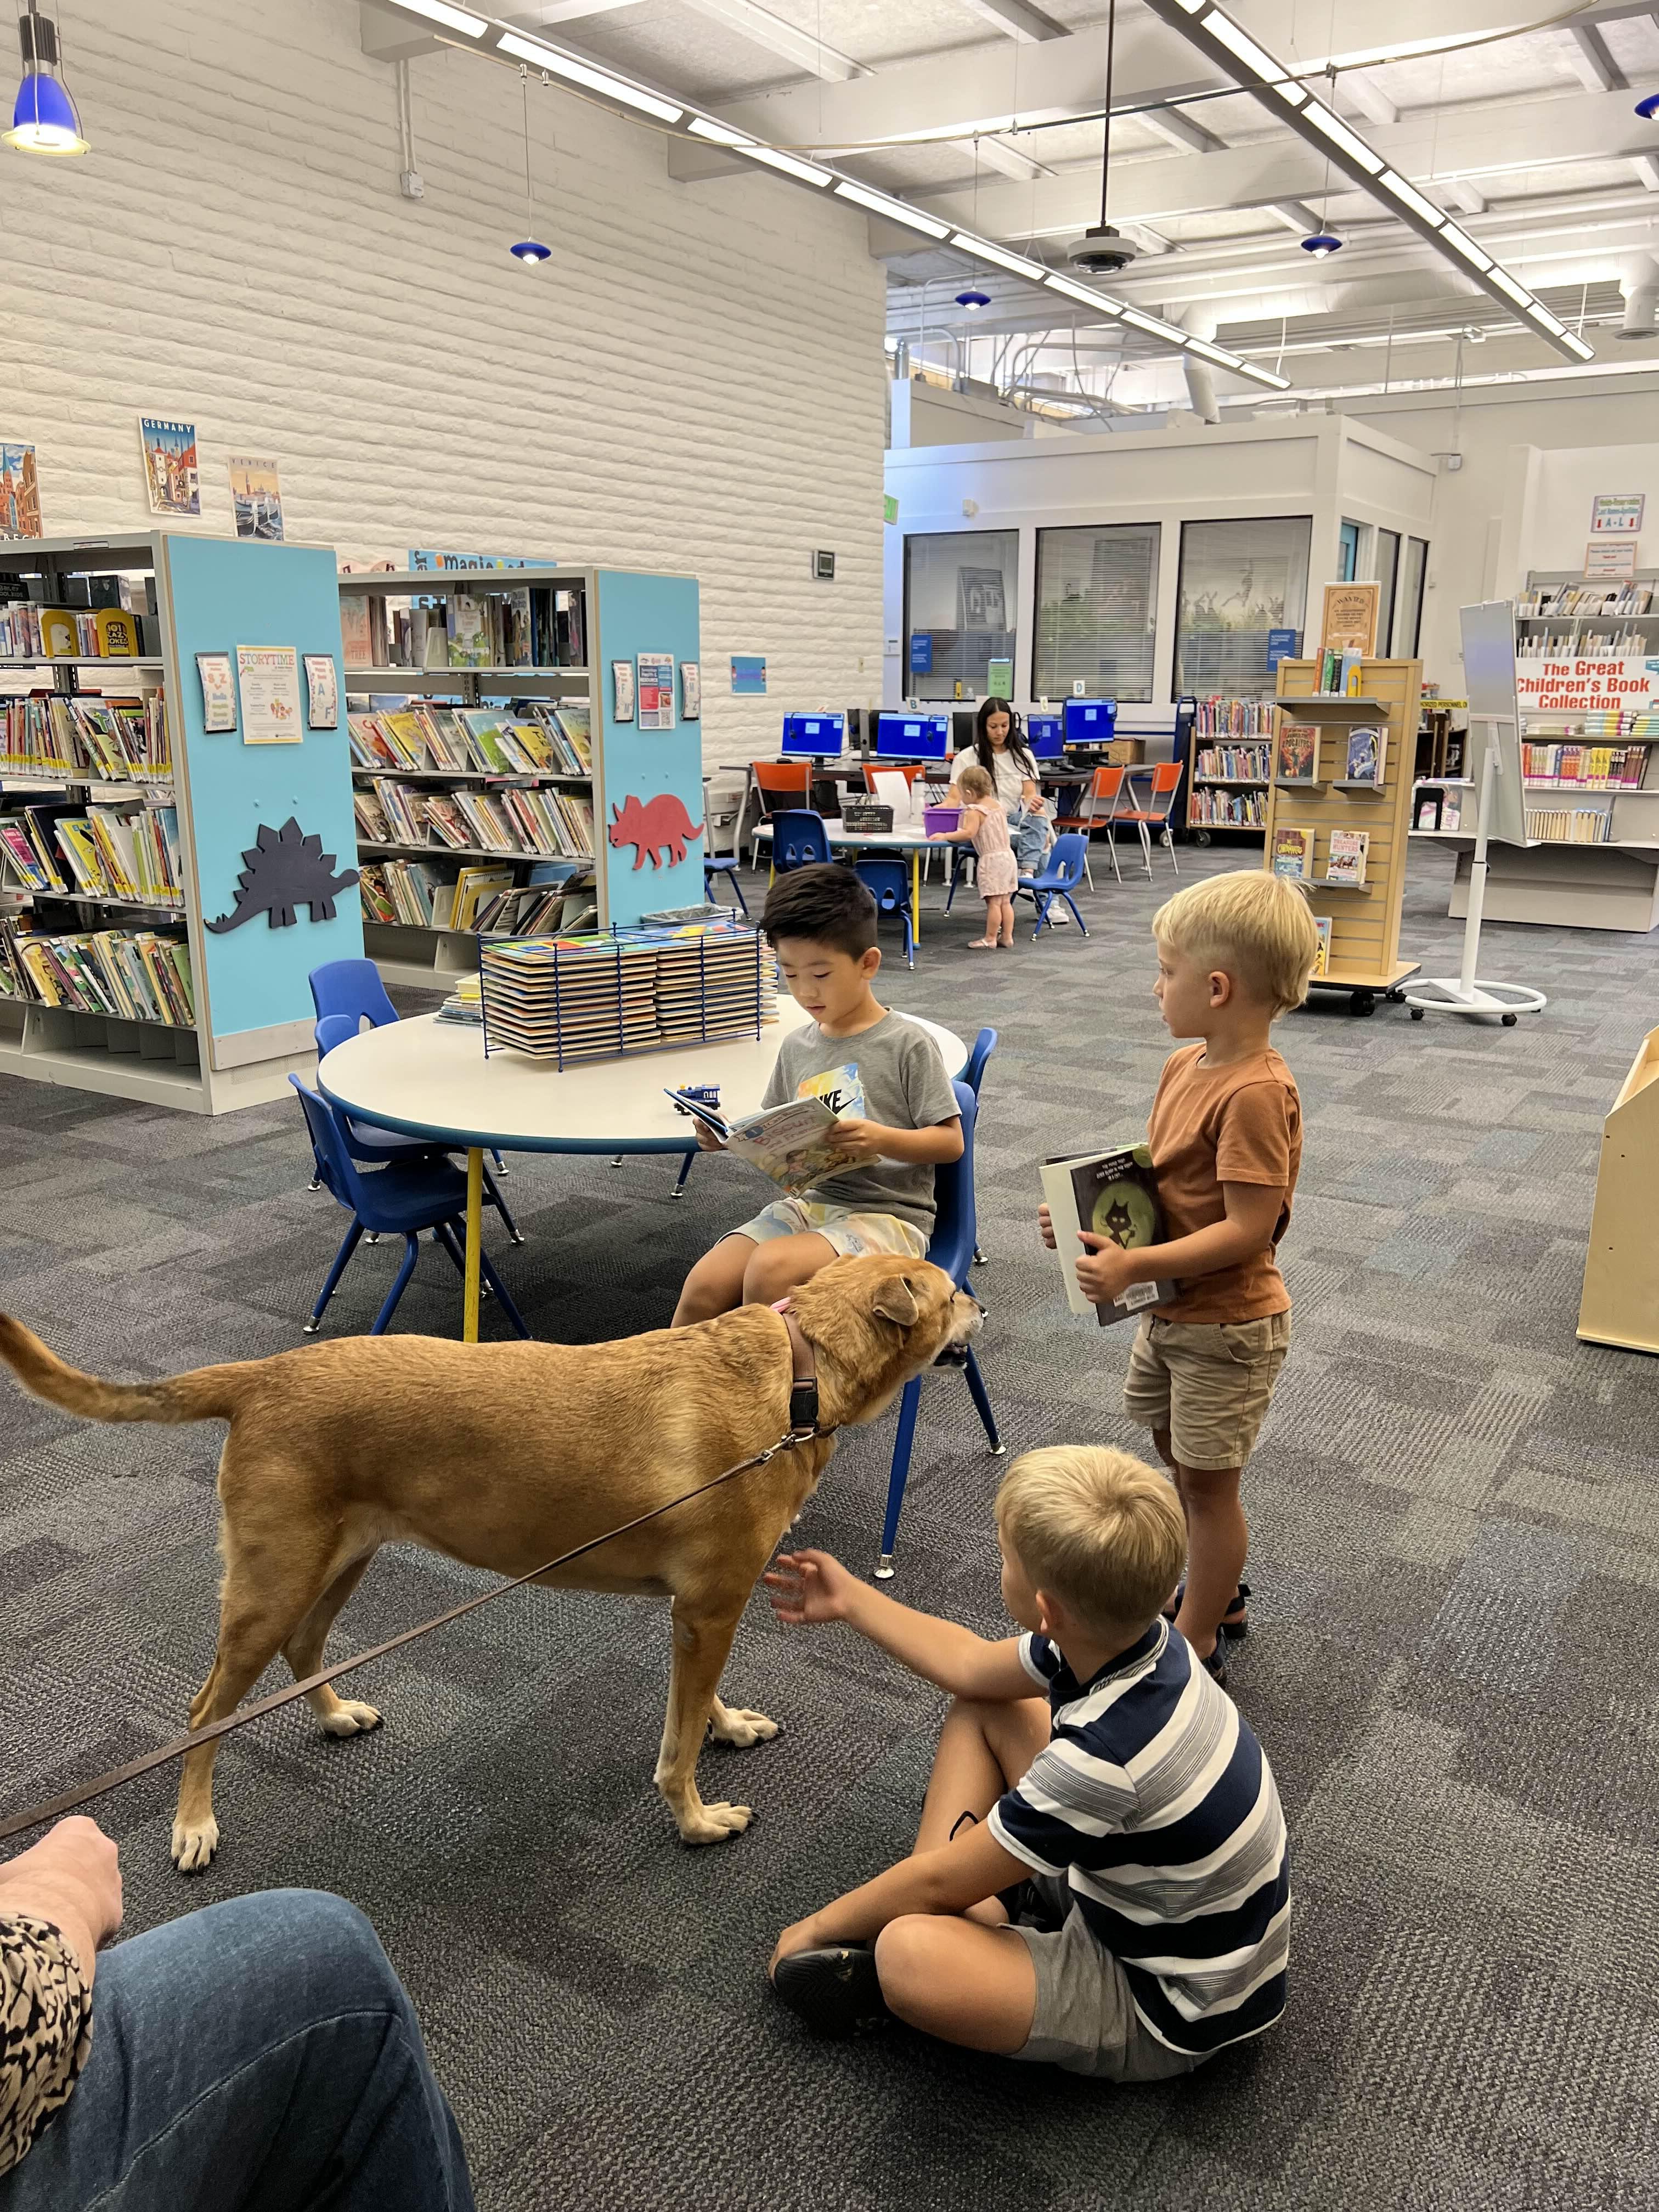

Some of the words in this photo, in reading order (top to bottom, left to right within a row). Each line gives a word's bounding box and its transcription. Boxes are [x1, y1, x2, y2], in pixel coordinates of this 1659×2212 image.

[144, 419, 191, 433] GERMANY
[232, 458, 275, 469] VENICE
[239, 653, 295, 665] STORYTIME
[1542, 663, 1569, 675] The
[1575, 661, 1624, 675] Great
[1517, 678, 1601, 692] Children's
[1607, 677, 1650, 692] Book
[911, 699, 917, 709] B
[1539, 695, 1621, 709] Collection
